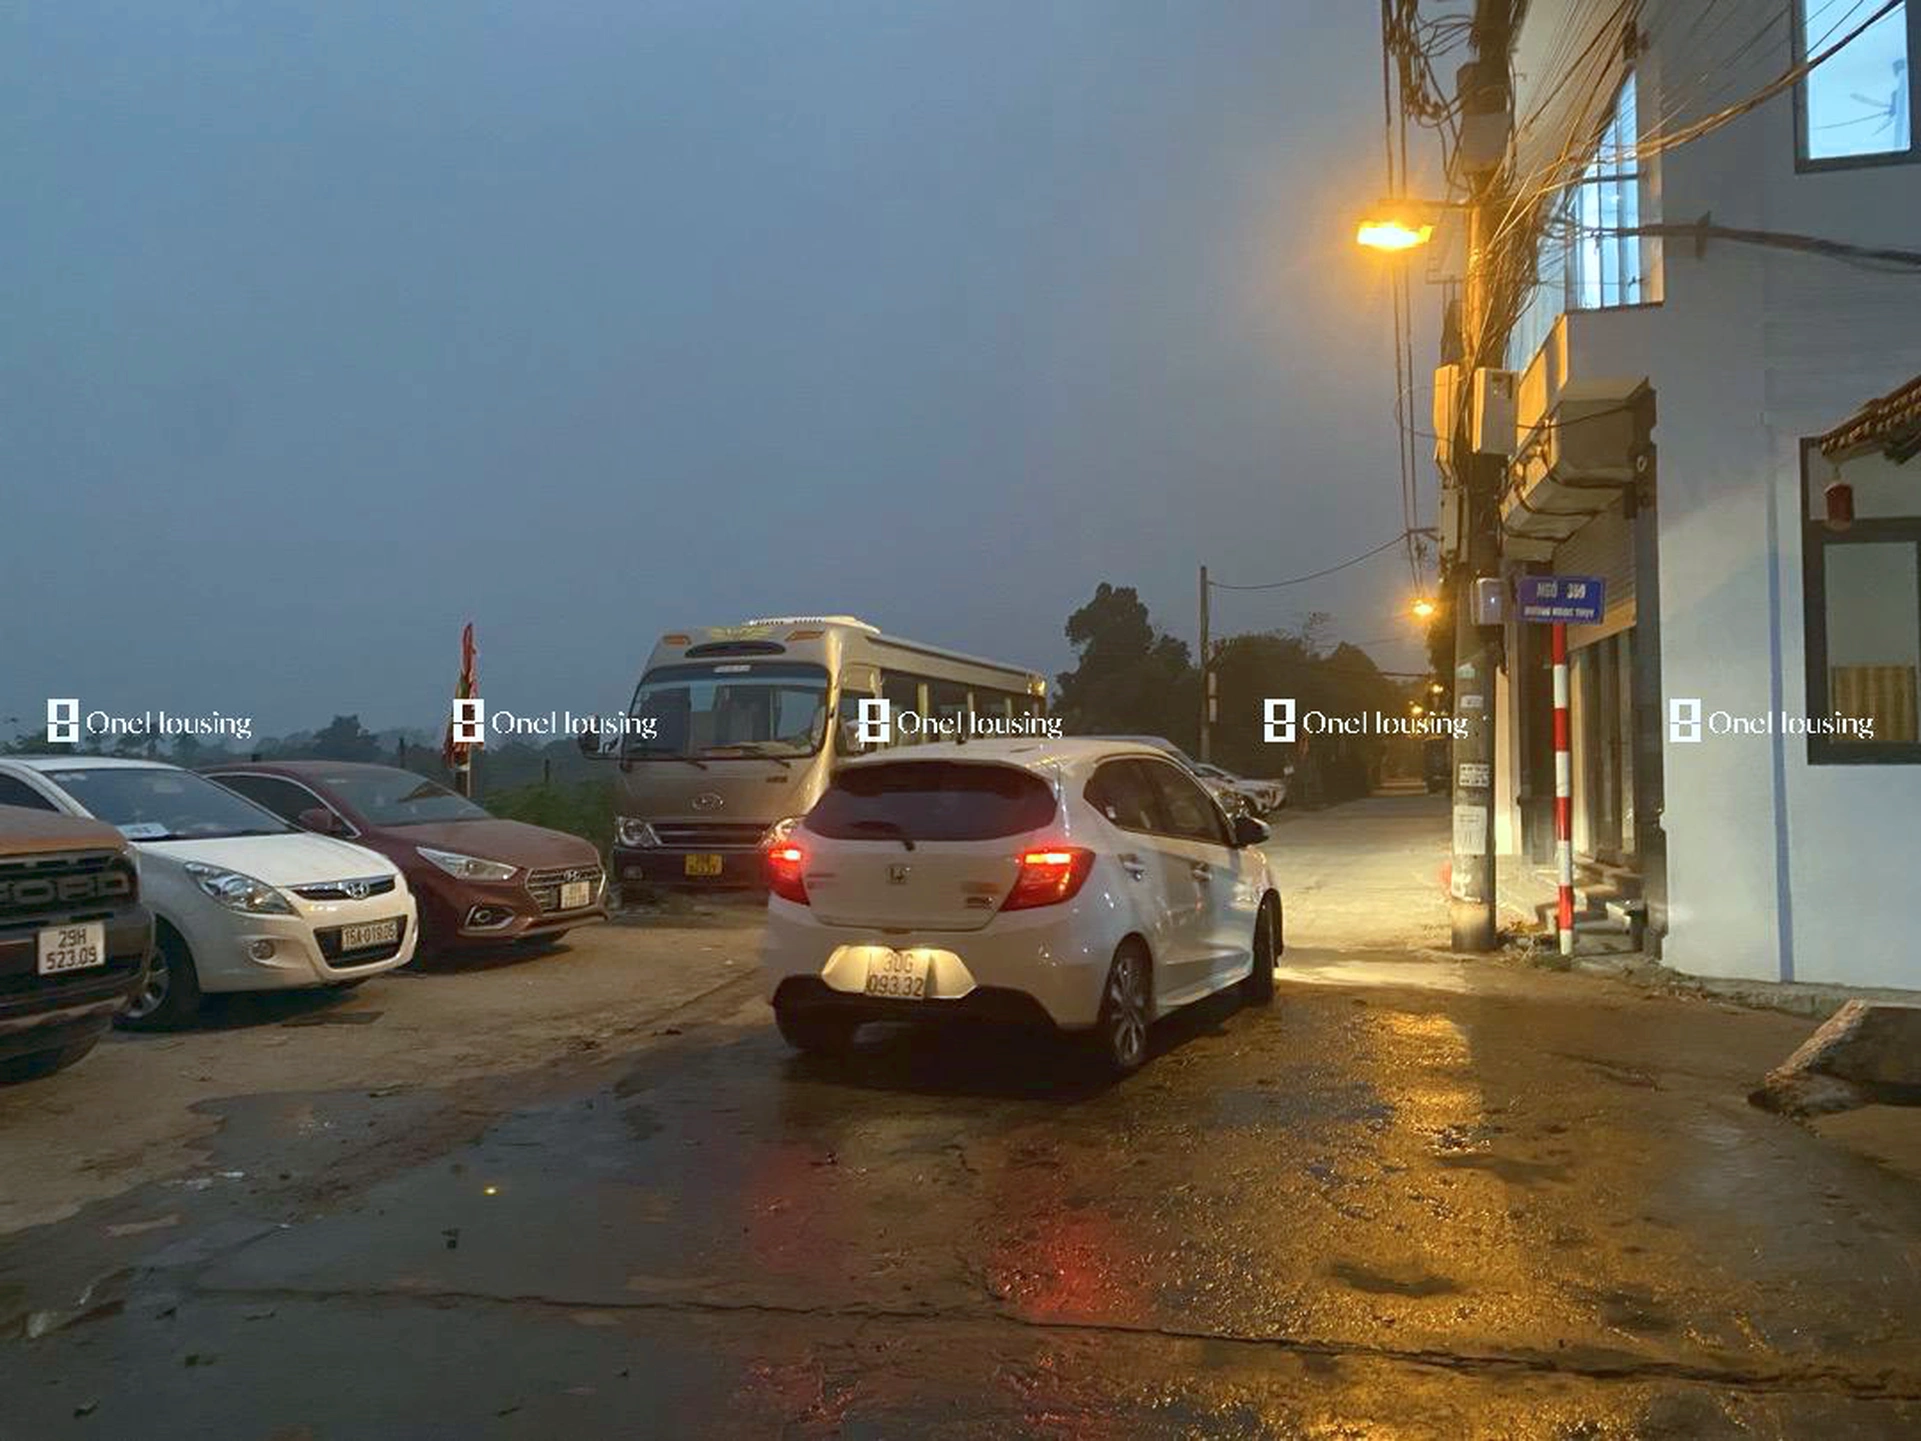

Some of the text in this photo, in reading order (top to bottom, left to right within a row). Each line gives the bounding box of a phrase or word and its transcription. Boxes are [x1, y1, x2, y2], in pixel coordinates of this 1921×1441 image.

[0, 872, 129, 905] ORD
[58, 928, 87, 948] 29H
[46, 945, 98, 970] 523.09
[883, 953, 913, 973] 30G
[866, 974, 925, 997] 093.32
